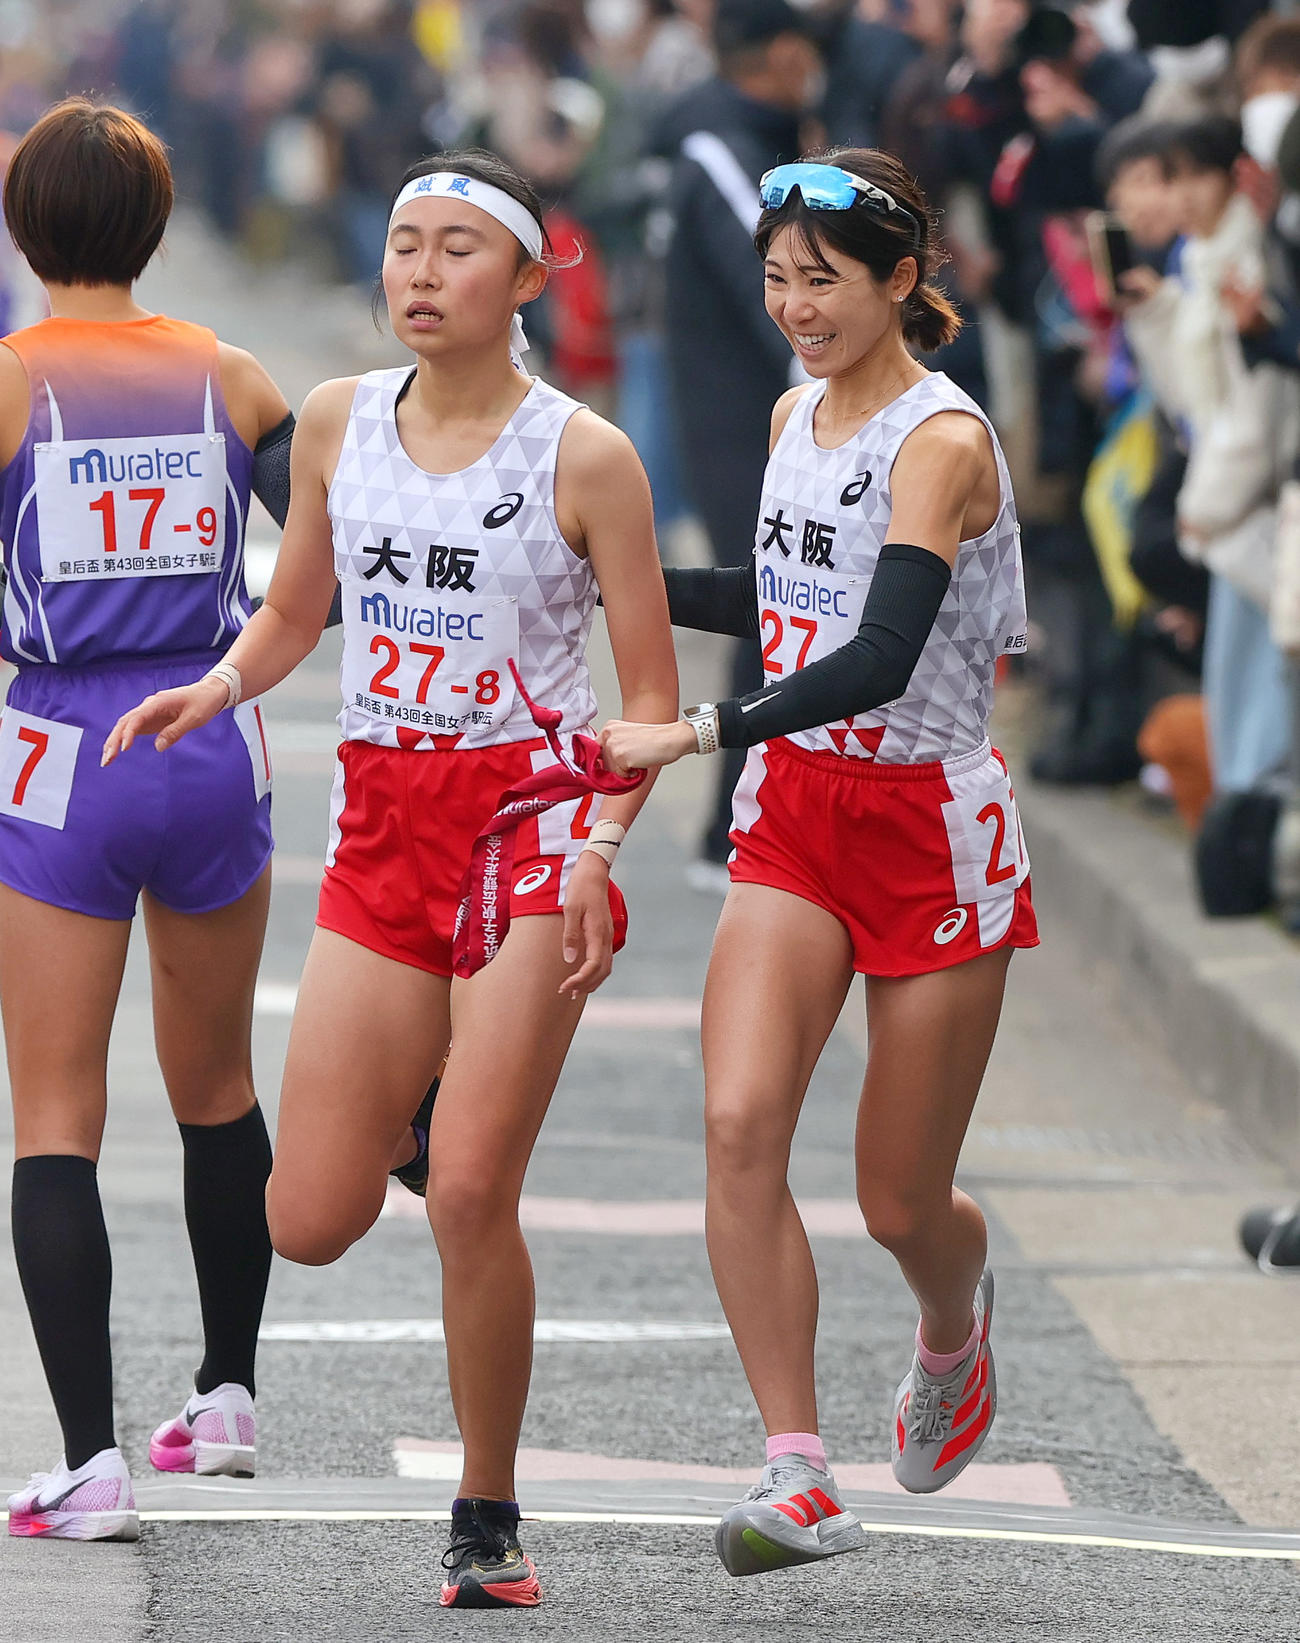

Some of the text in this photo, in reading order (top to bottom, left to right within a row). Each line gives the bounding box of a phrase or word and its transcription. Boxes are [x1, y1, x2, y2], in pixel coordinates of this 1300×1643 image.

[89, 487, 217, 553] 17-9
[762, 509, 836, 570] 大阪
[59, 560, 100, 575] 皇后盃
[362, 537, 480, 593] 大阪
[368, 634, 500, 705] 27-8
[761, 608, 818, 675] 27
[355, 692, 381, 715] 皇后盃
[0, 718, 49, 807] 7
[975, 787, 1024, 887] 2
